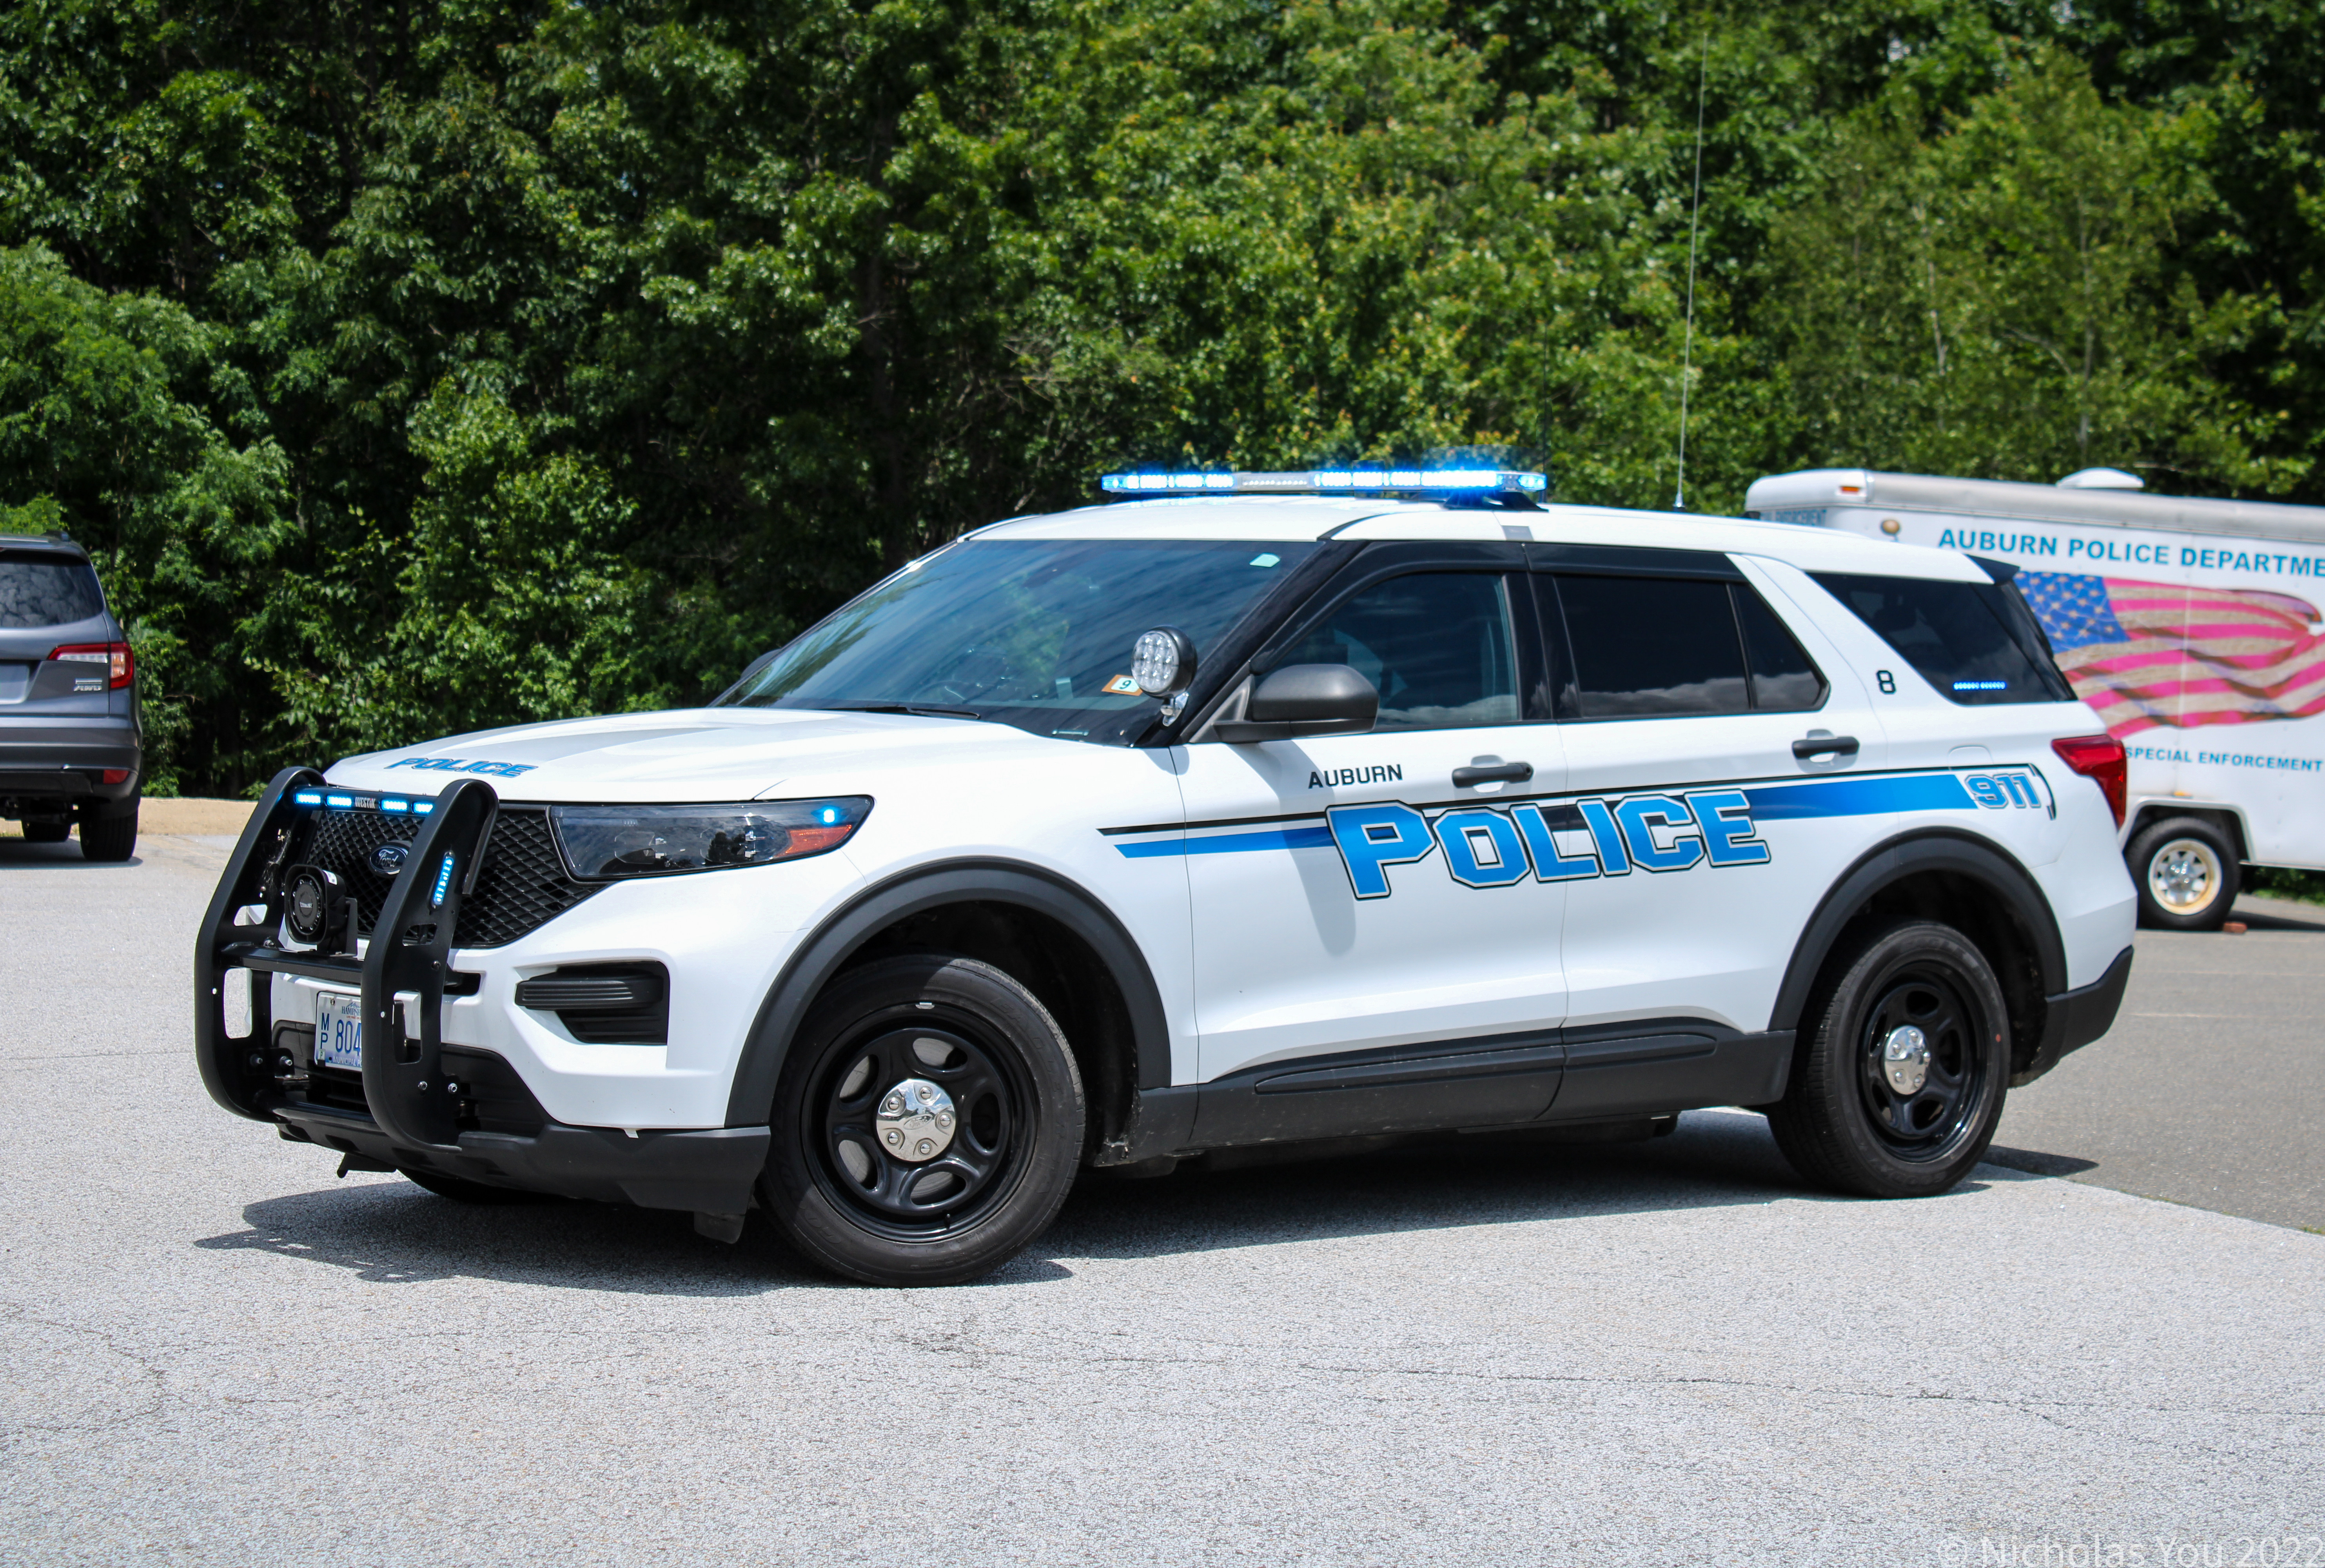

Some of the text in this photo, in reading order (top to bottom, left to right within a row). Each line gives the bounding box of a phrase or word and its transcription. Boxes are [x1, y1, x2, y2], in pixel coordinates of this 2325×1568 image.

[1938, 529, 2057, 556] AUBURN
[2069, 539, 2169, 564] POLICE
[1119, 680, 1131, 690] 9
[1876, 670, 1896, 694] 8
[383, 758, 539, 778] POLICE
[2125, 746, 2324, 772] SPECIAL ENFORCEMENT
[1308, 764, 1403, 789] AUBURN
[1965, 773, 2041, 809] 911
[1325, 788, 1771, 900] POLICE
[376, 849, 399, 867] Ford
[336, 1020, 362, 1056] 804
[333, 1056, 357, 1066] MUNICIPAL
